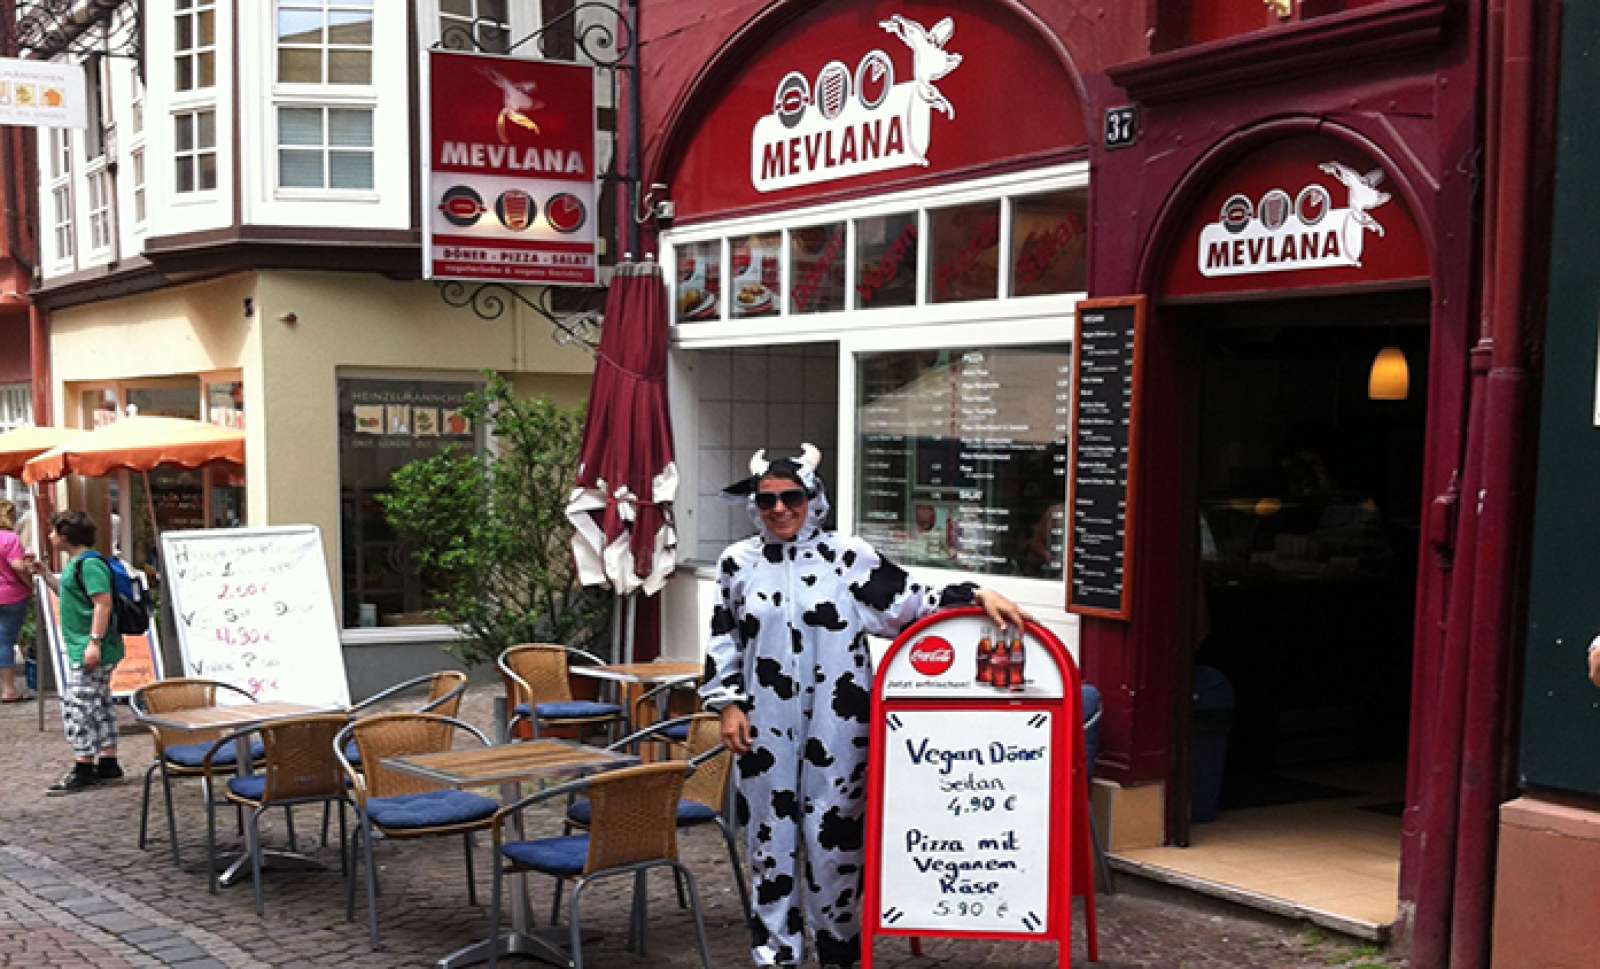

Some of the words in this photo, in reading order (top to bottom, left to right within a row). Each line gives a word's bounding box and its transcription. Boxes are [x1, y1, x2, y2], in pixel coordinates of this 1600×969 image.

[1108, 111, 1132, 141] 37
[440, 140, 584, 174] MEVLANA
[761, 116, 905, 179] MEVLANA
[443, 248, 487, 260] DÖNER
[501, 251, 540, 263] PIZZA
[552, 253, 589, 265] SALAT
[1206, 231, 1341, 269] MEVLANA
[905, 737, 984, 774] Vegan
[989, 741, 1048, 763] Döner
[938, 772, 1005, 792] Seitan
[947, 796, 995, 816] 4.90
[906, 828, 965, 853] Pizza
[977, 830, 1021, 851] mit
[938, 878, 1000, 895] Käse
